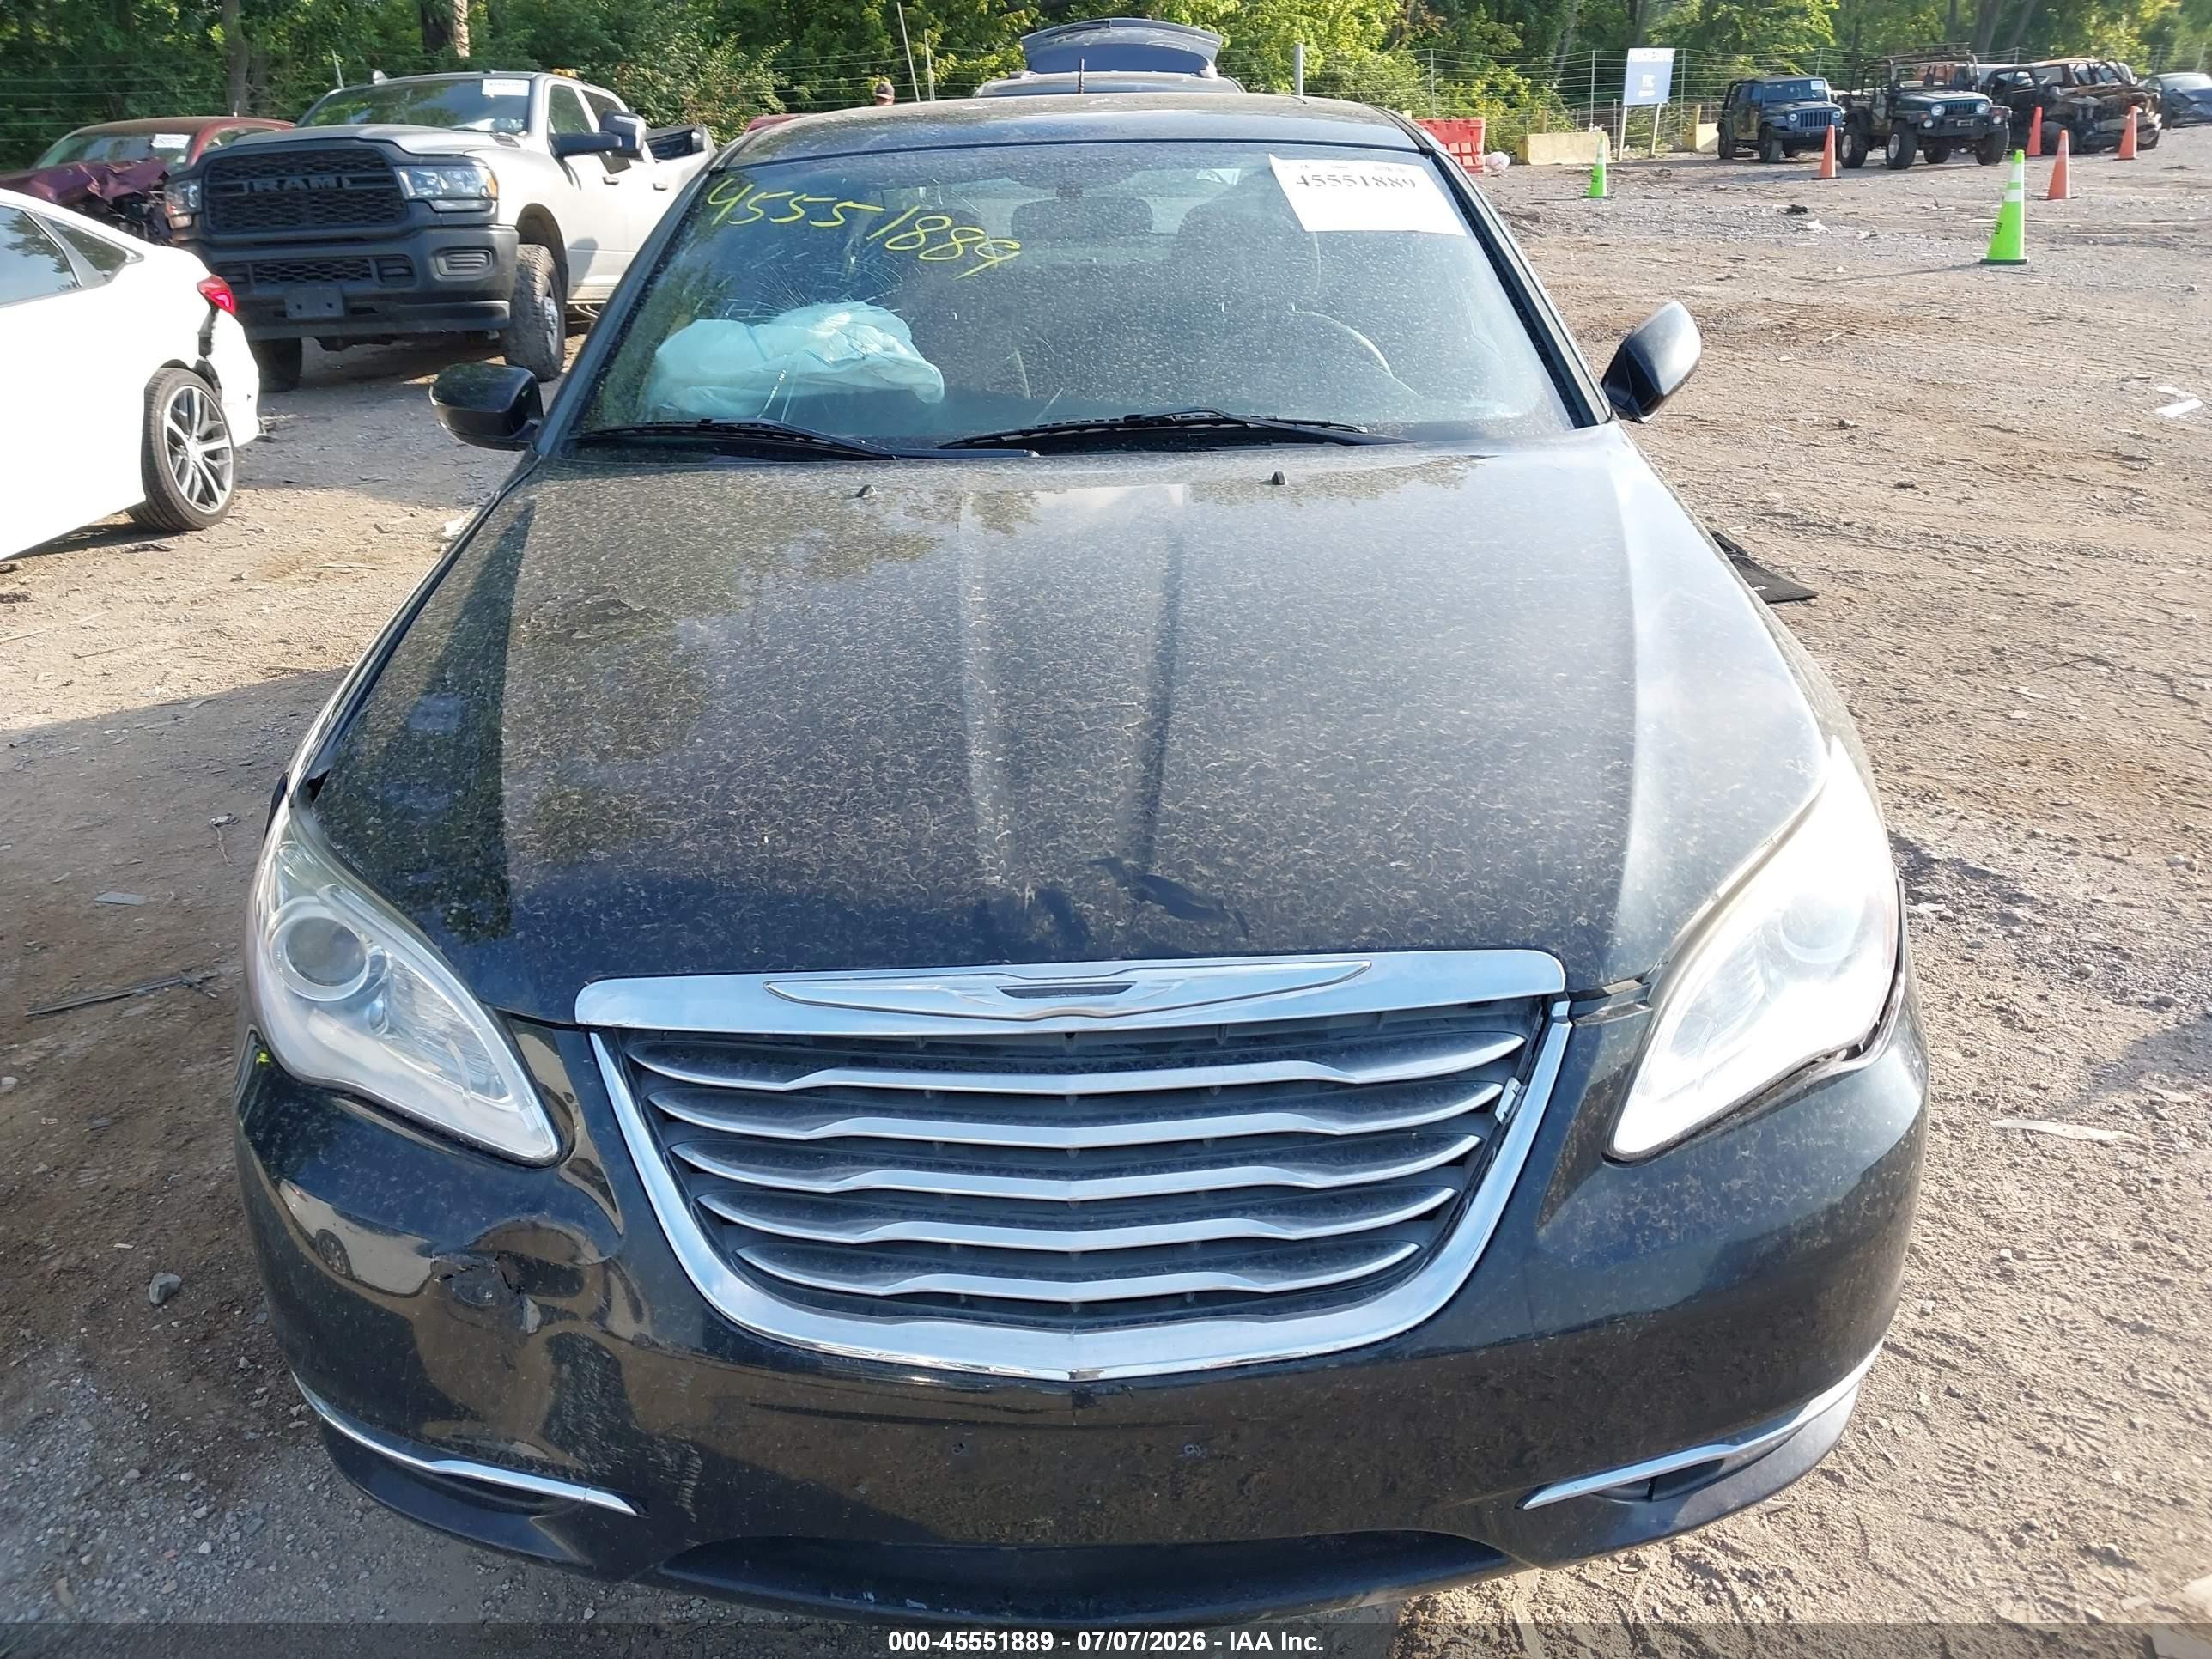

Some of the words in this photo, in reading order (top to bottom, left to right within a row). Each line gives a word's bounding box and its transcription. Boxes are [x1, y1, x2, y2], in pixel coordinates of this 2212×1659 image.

[252, 175, 337, 192] RAM
[1296, 173, 1417, 189] 45551889
[707, 177, 1022, 280] 45551889
